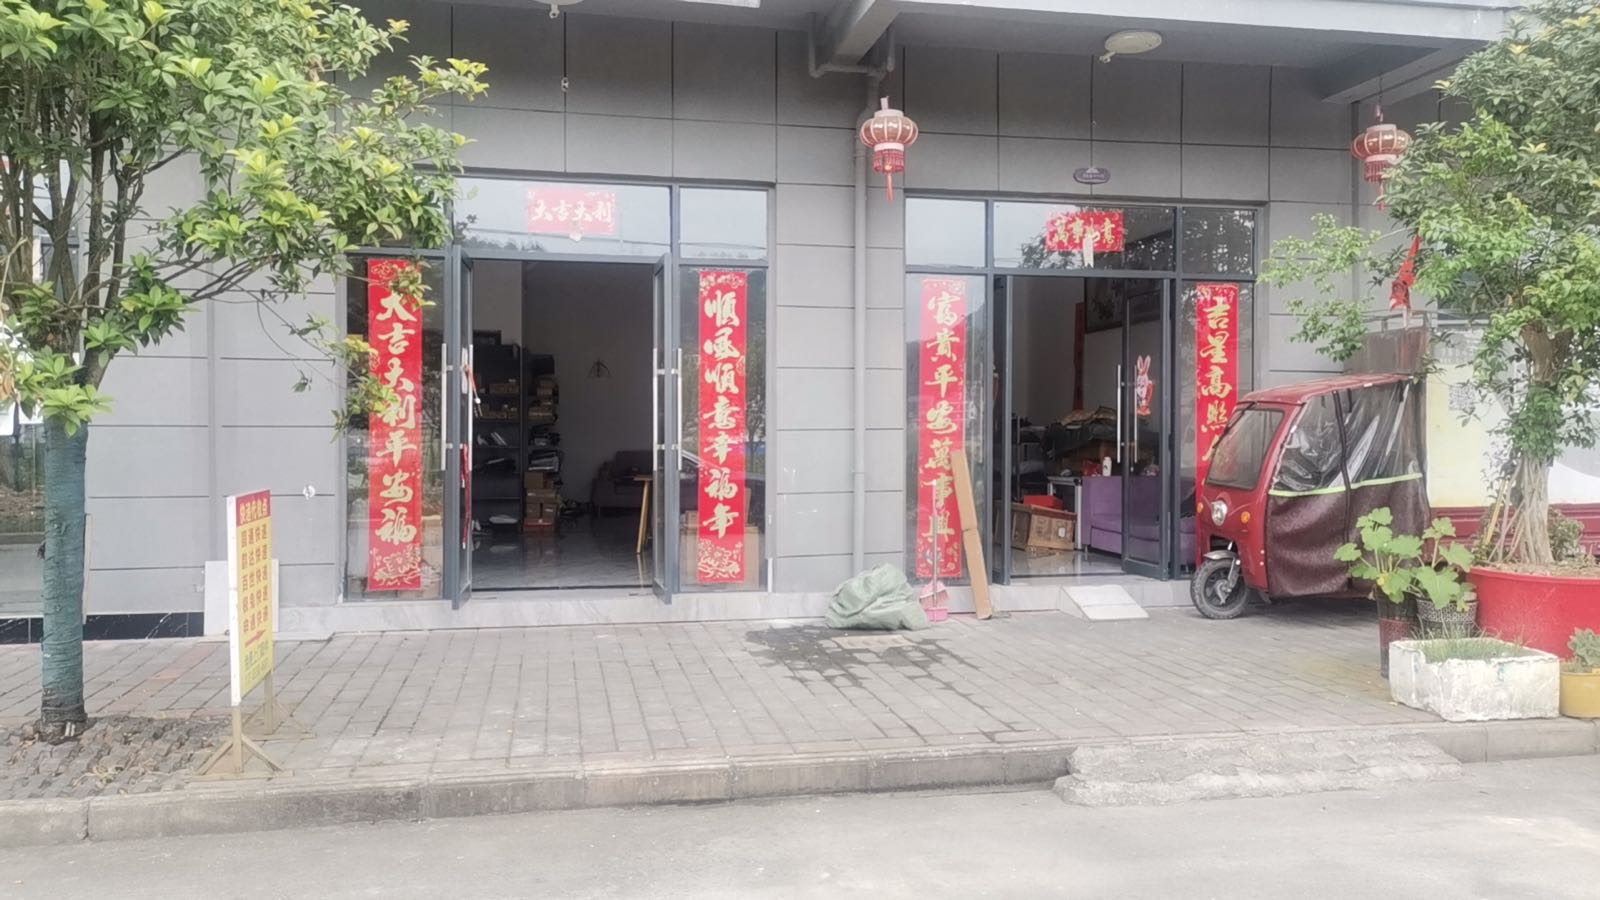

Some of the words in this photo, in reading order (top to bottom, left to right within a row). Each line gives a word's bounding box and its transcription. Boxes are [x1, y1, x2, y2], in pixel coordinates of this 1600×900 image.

[531, 199, 613, 222] 大吉大利
[375, 291, 418, 546] 大吉大利平安福
